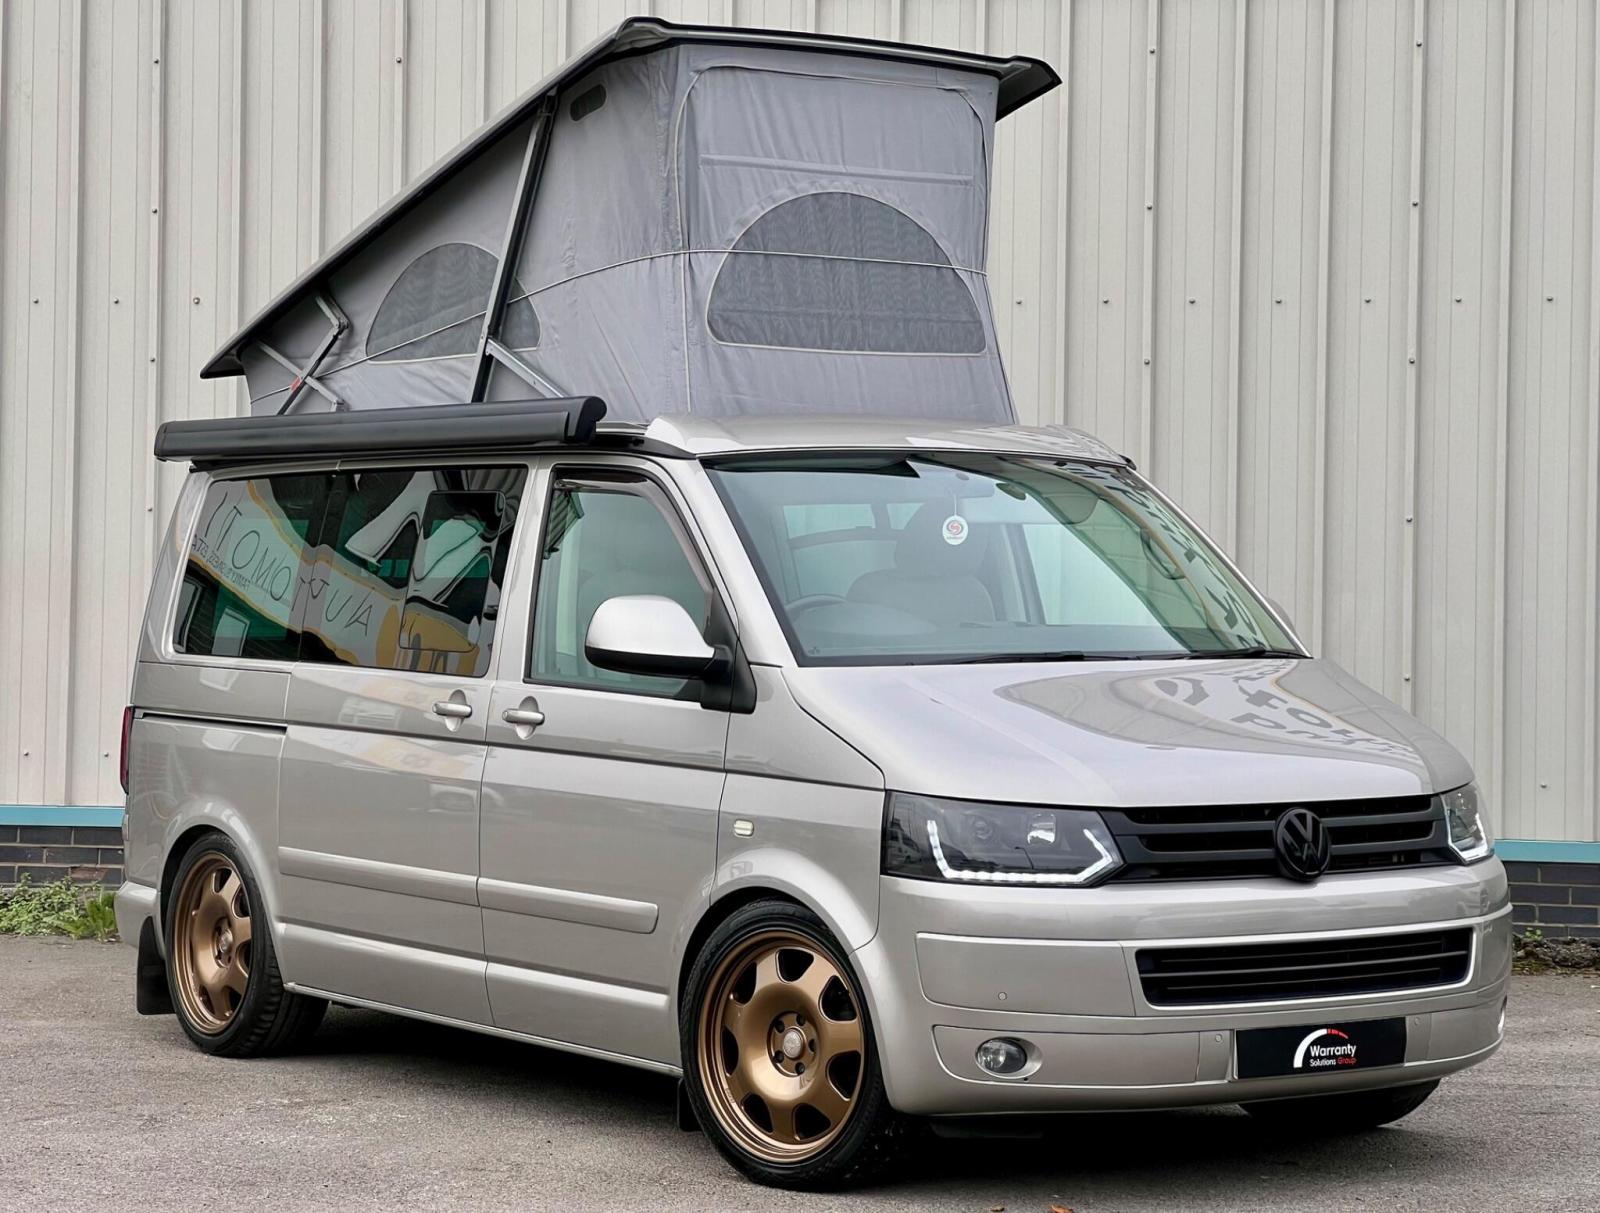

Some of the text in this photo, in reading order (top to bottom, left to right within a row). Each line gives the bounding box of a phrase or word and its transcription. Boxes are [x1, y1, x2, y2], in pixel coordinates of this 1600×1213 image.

[1310, 1043, 1356, 1057] Warranty
[1310, 1056, 1357, 1067] Solutions Group
